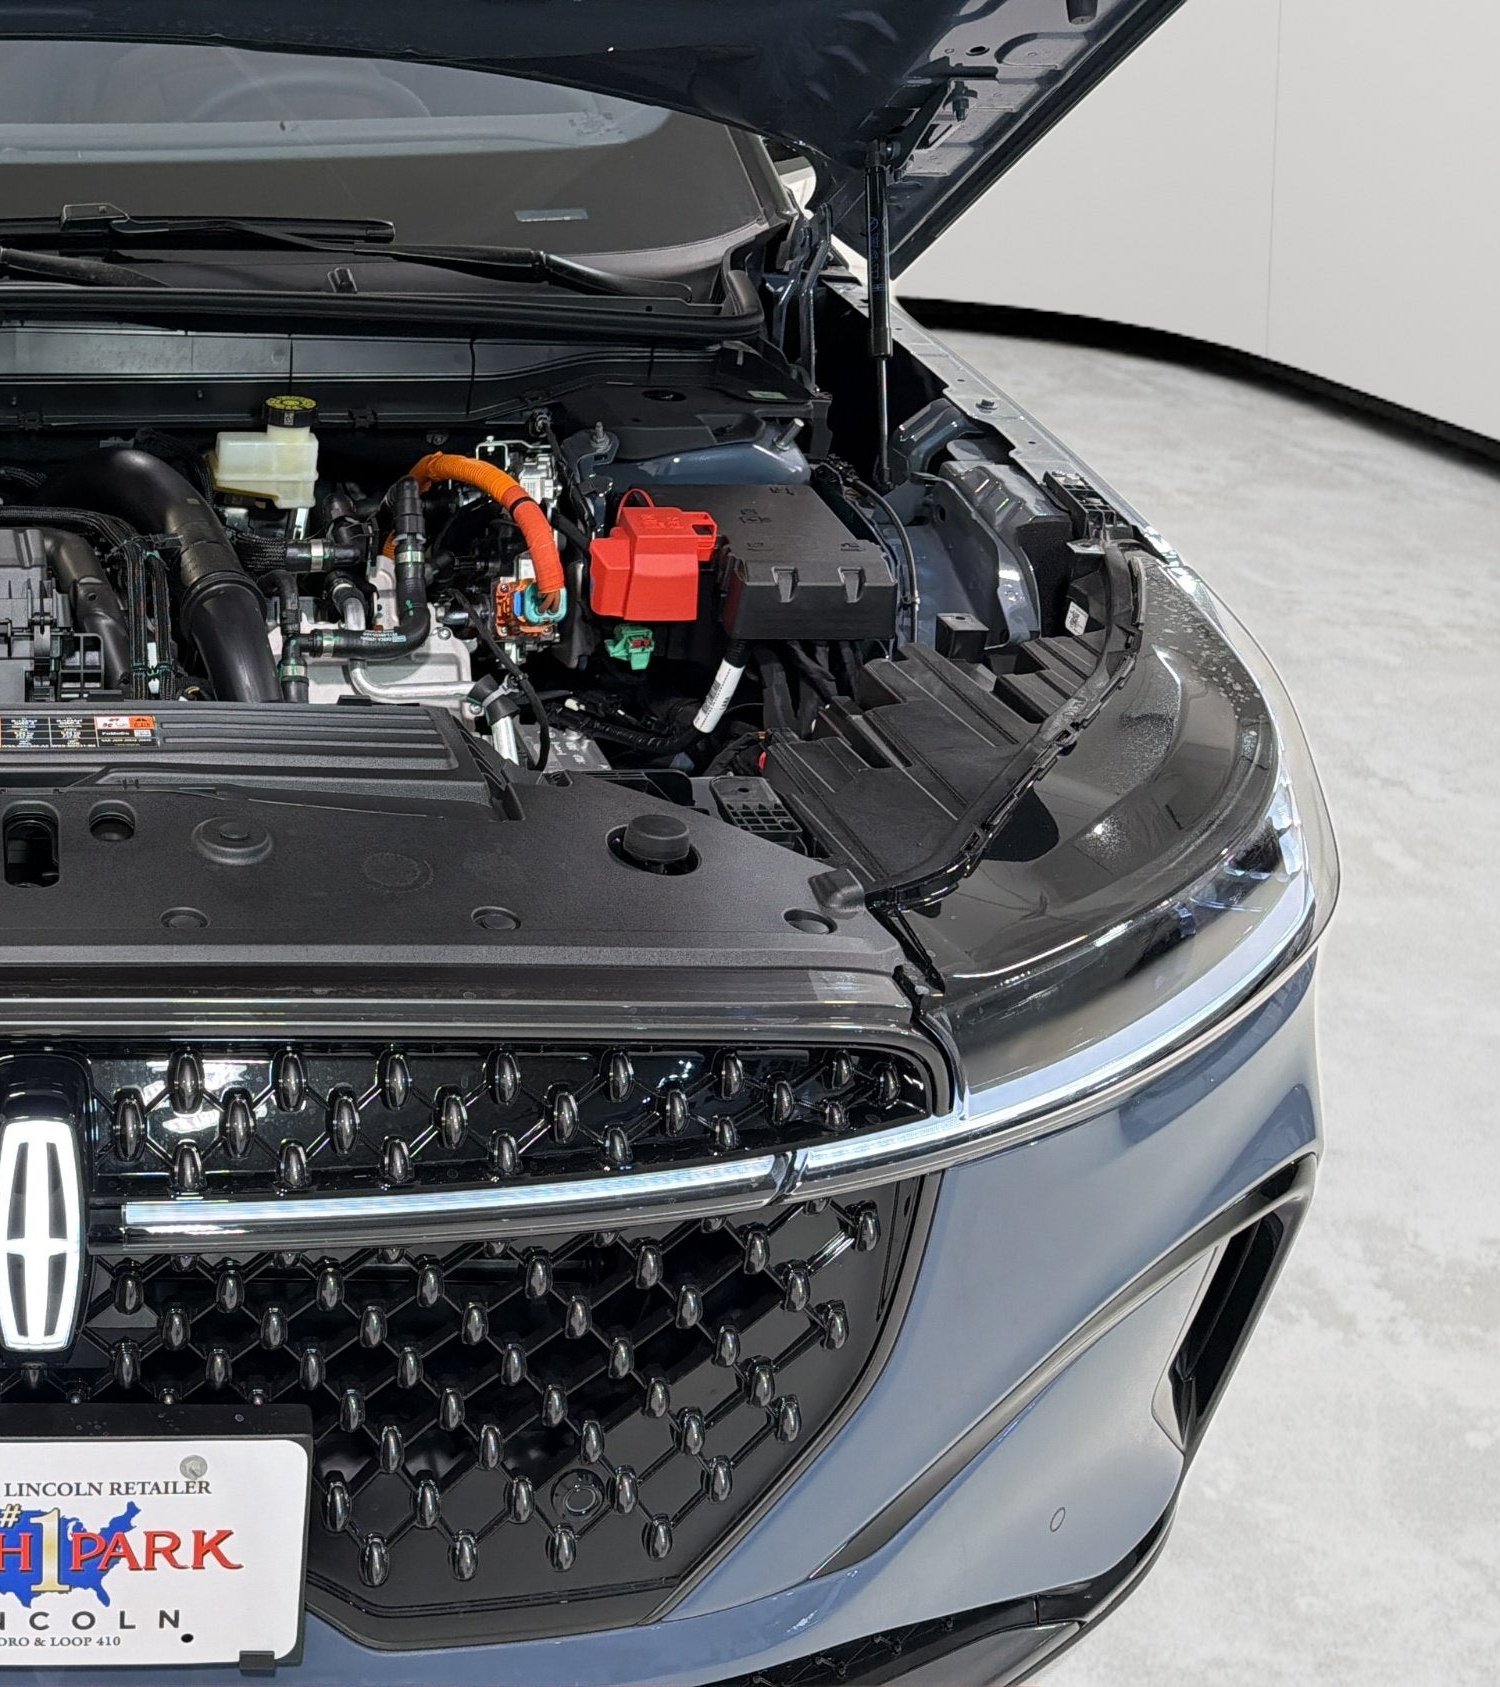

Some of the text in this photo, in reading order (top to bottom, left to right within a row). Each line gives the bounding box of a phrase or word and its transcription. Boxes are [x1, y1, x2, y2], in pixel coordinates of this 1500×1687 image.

[3, 1481, 104, 1498] LINCOLN
[108, 1479, 213, 1497] RETAILER
[69, 1528, 245, 1573] PARK
[33, 1636, 47, 1648] &
[50, 1636, 93, 1648] LOOP
[96, 1635, 122, 1647] 410
